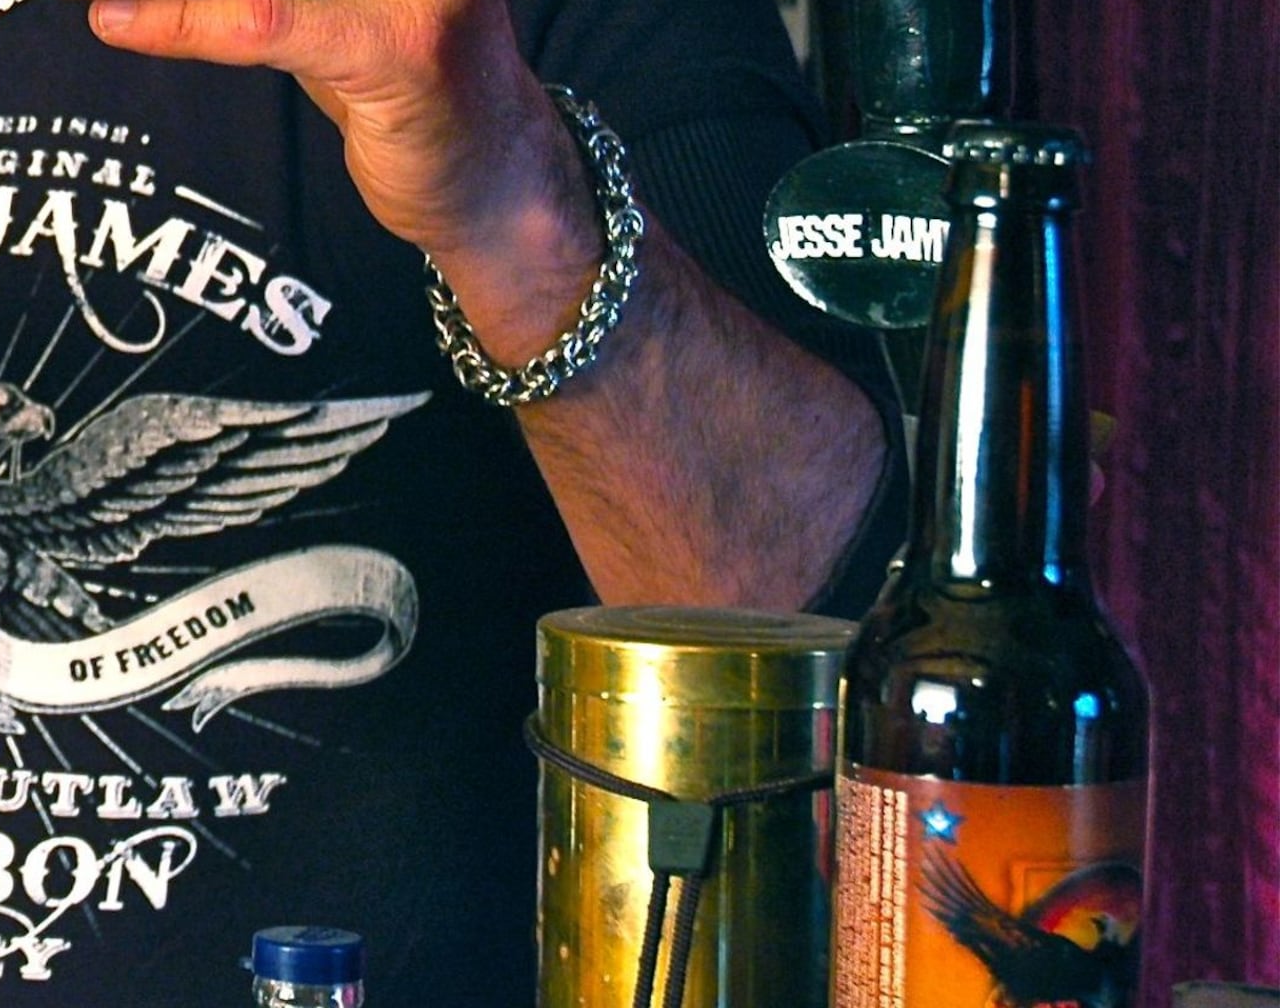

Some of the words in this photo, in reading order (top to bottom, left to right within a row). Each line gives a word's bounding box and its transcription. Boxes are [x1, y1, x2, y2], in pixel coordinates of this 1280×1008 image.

[772, 213, 864, 261] JESSE
[871, 213, 951, 263] JAM
[69, 656, 105, 683] OF
[118, 590, 257, 675] FREEDOM
